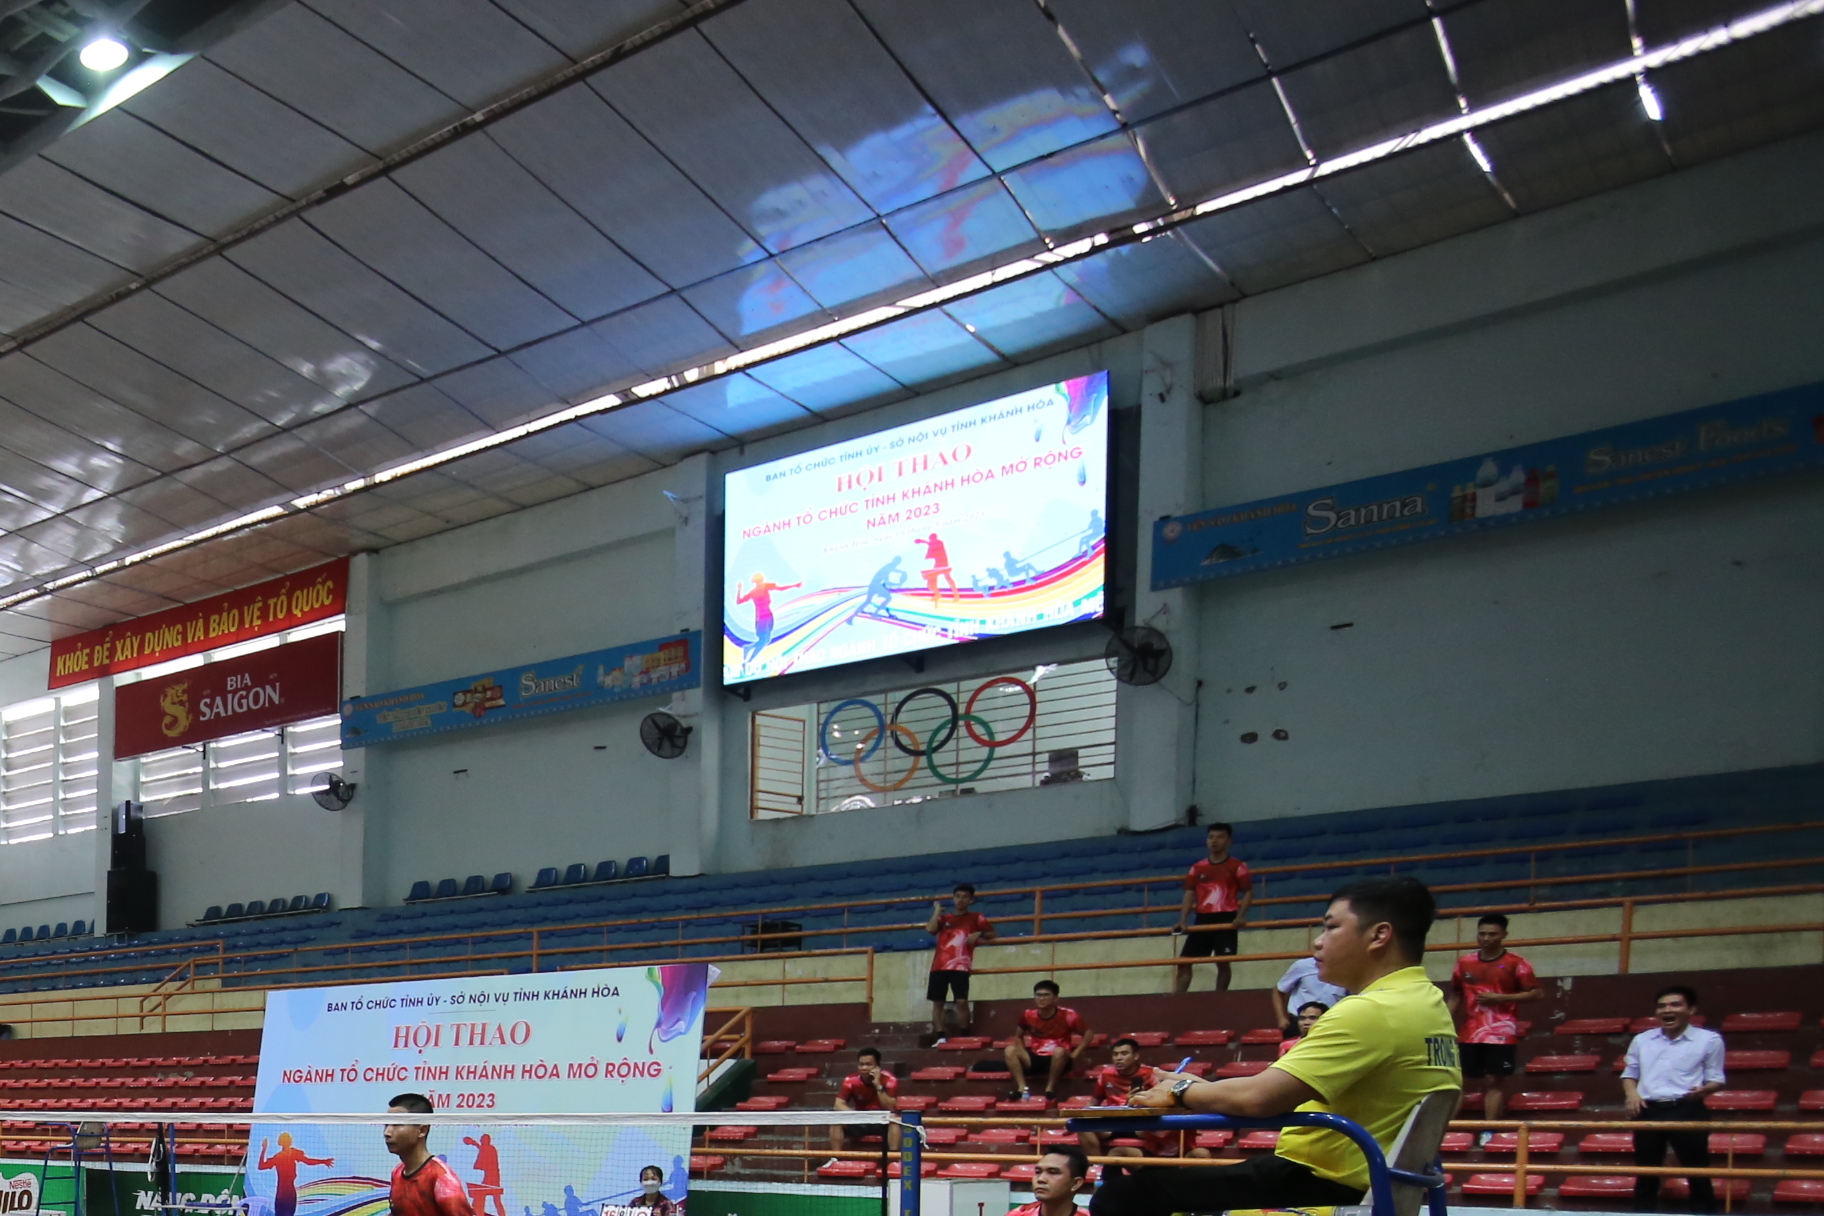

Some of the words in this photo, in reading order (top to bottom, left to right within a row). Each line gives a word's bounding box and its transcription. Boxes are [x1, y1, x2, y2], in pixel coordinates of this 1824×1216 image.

[765, 470, 786, 482] BAN
[805, 455, 836, 472] CHỨC
[981, 406, 1023, 425] KHÁNH
[836, 463, 884, 493] HỘI
[892, 443, 972, 478] THAO
[742, 517, 791, 539] NGÀNH
[817, 500, 859, 521] CHỨC
[901, 477, 955, 502] KHÁNH
[960, 466, 995, 486] HÒA
[1033, 446, 1083, 471] RỘNG
[867, 510, 900, 529] NĂM
[905, 502, 940, 521] 2023
[1305, 495, 1425, 537] Sanna
[57, 645, 90, 676] KHỎE
[93, 631, 113, 667] ĐỂ
[115, 632, 141, 661] XÂY
[144, 625, 182, 657] DỰNG
[187, 613, 204, 643] VÀ
[209, 603, 239, 637] BẢO
[243, 598, 264, 631] VỆ
[267, 582, 290, 621] TỔ
[291, 572, 334, 616] QUỐC
[227, 673, 251, 691] BIA
[520, 672, 580, 698] Sanest
[199, 683, 281, 721] SAIGON
[327, 1002, 347, 1012] BAN
[350, 996, 364, 1011] TỔ
[366, 996, 397, 1010] CHỨC
[400, 994, 423, 1008] TỈNH
[427, 992, 441, 1007] ỦY
[450, 990, 466, 1005] SỞ
[469, 990, 490, 1007] NỘI
[494, 991, 509, 1006] VỤ
[513, 987, 539, 1001] TỈNH
[543, 987, 587, 1001] KHÁNH
[591, 985, 620, 998] HÒA
[392, 1020, 443, 1054] HỘI
[450, 1020, 532, 1047] THAO
[282, 1065, 335, 1084] NGÀNH
[339, 1059, 359, 1082] TỔ
[363, 1062, 409, 1082] CHỨC
[414, 1060, 450, 1081] TỈNH
[454, 1060, 516, 1081] KHÁNH
[520, 1059, 561, 1080] HÒA
[567, 1056, 599, 1079] MỞ
[604, 1057, 662, 1084] RỘNG
[426, 1090, 451, 1109] ĂM
[456, 1093, 496, 1109] 2023
